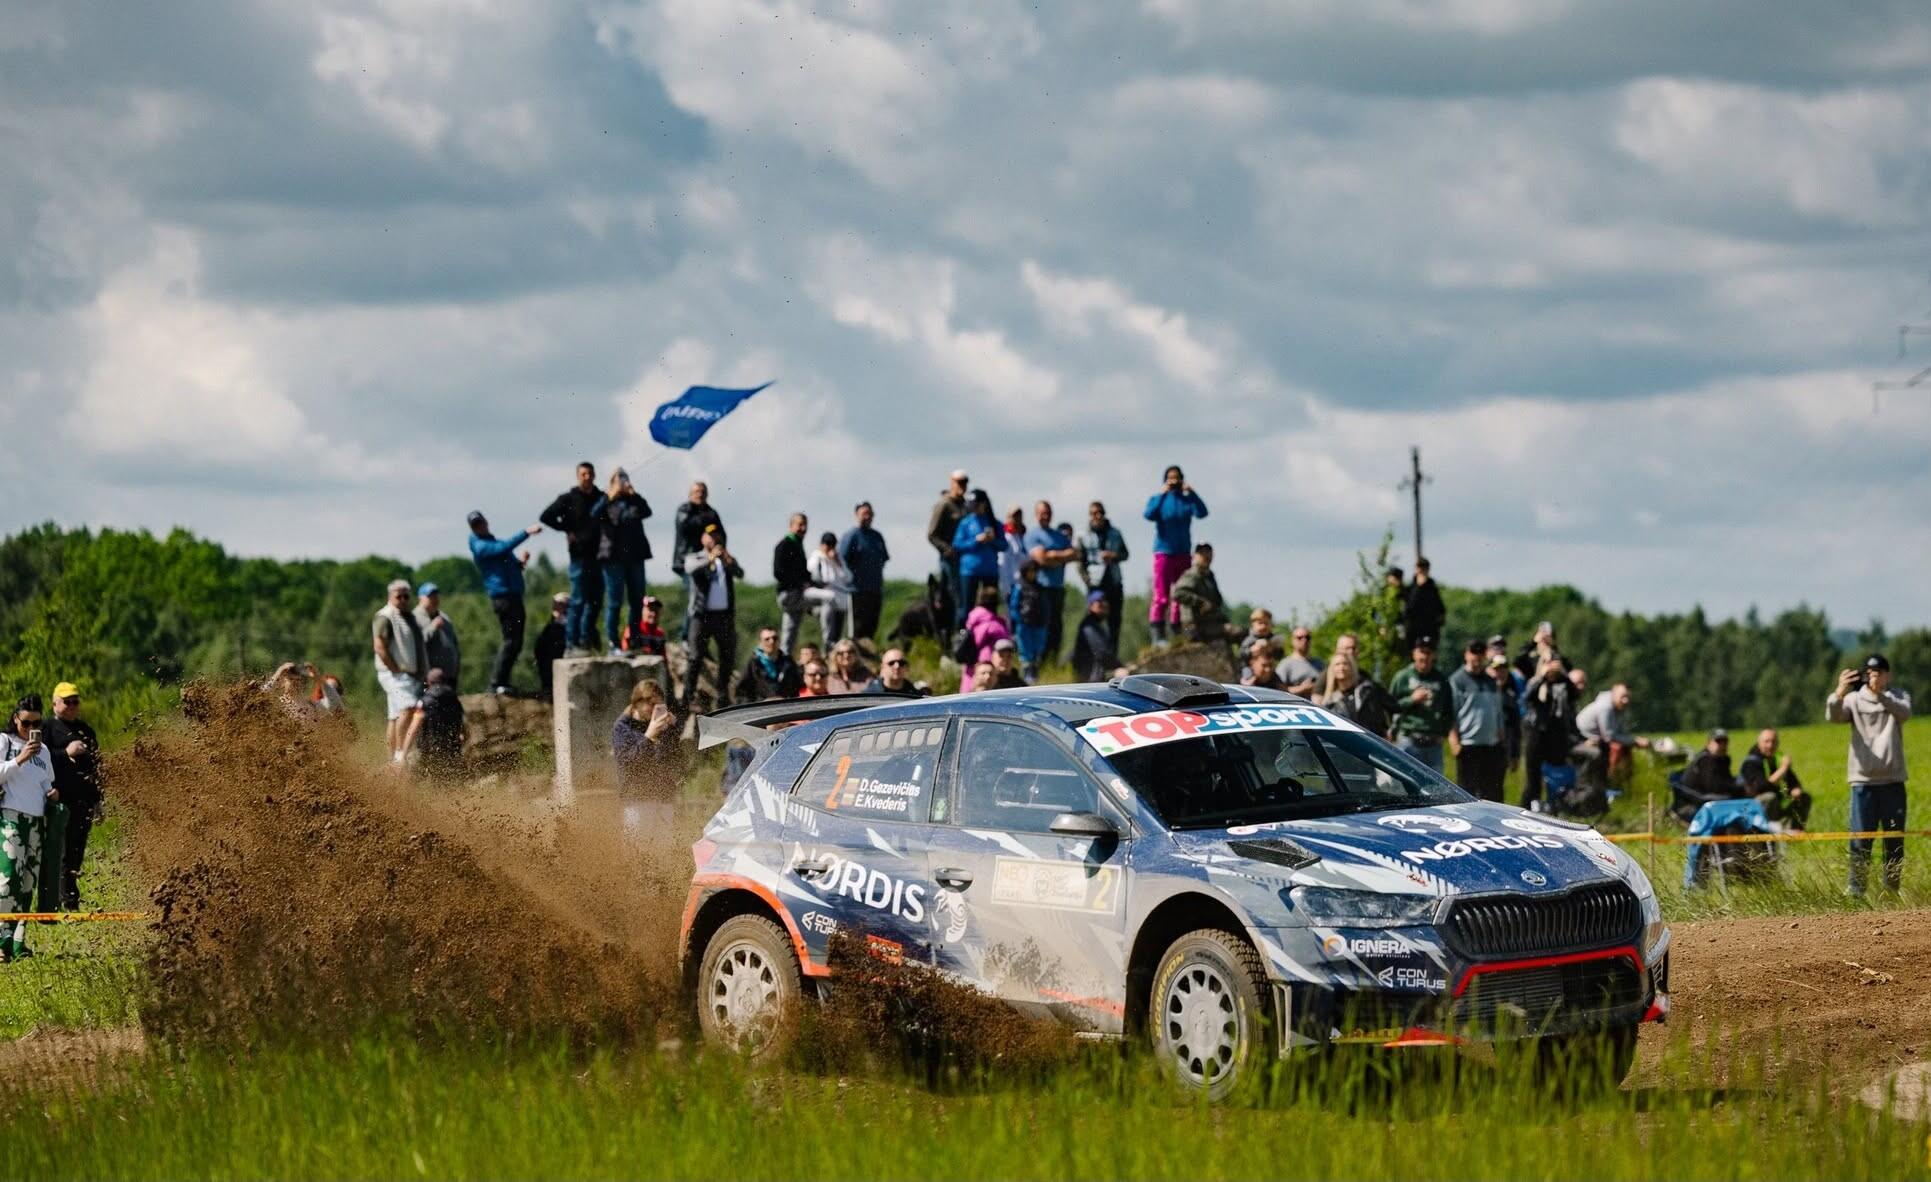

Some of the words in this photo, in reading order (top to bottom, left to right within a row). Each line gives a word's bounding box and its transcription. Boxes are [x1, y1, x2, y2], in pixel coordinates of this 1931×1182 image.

[825, 755, 852, 810] 2
[1401, 835, 1564, 864] NØRDIS
[1092, 868, 1112, 908] 2
[814, 913, 838, 929] CON
[1350, 939, 1410, 954] IGNERA
[1397, 968, 1427, 979] CON
[1397, 979, 1446, 990] TURUS
